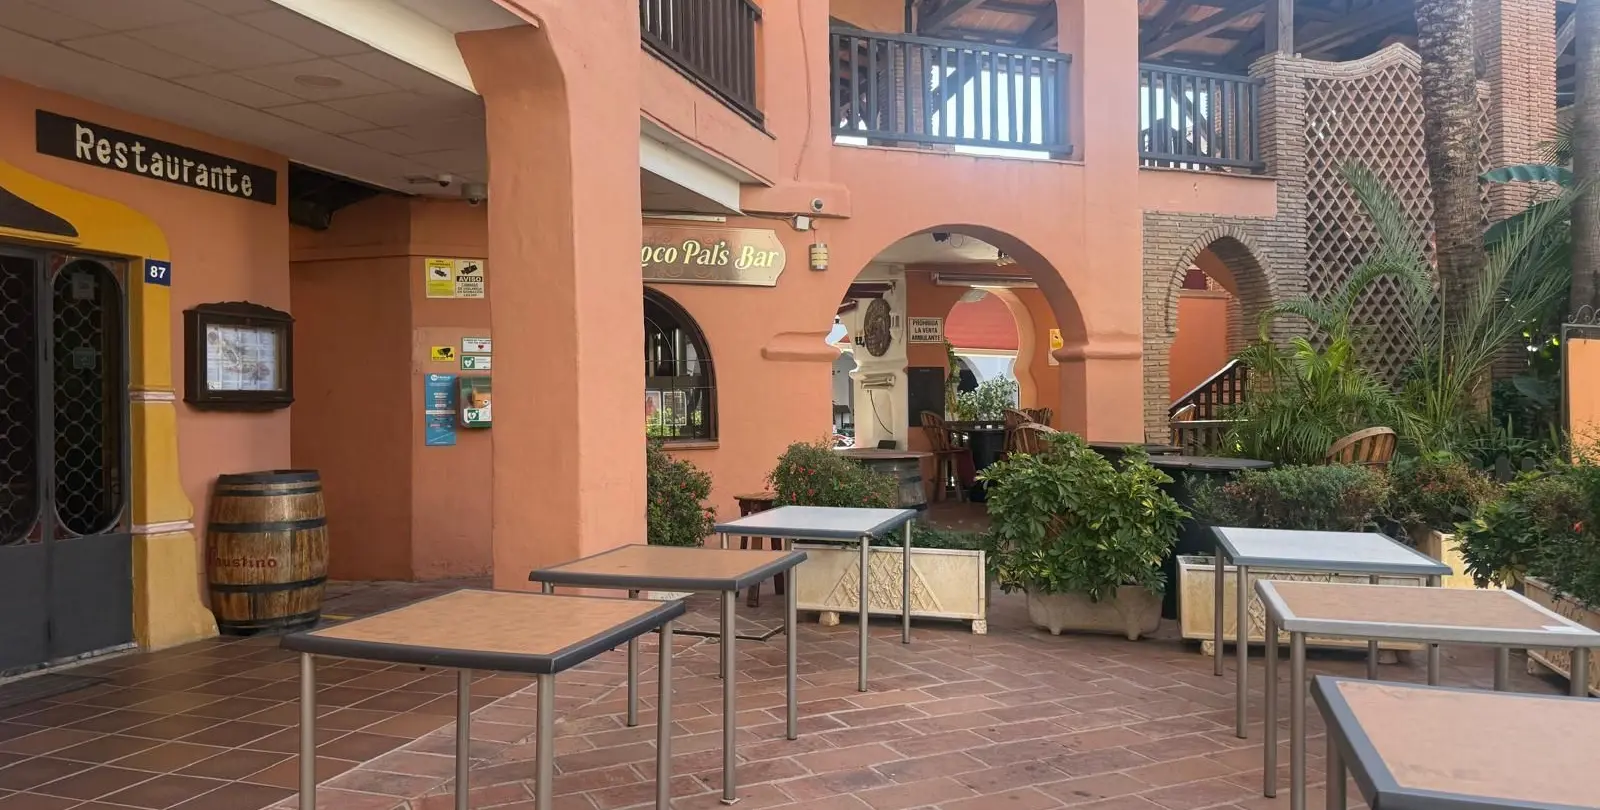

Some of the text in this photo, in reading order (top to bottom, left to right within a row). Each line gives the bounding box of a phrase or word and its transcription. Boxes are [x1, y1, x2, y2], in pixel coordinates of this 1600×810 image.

[75, 123, 253, 197] Restaurante
[641, 240, 779, 270] oco Pal's Bar
[149, 266, 166, 280] 87
